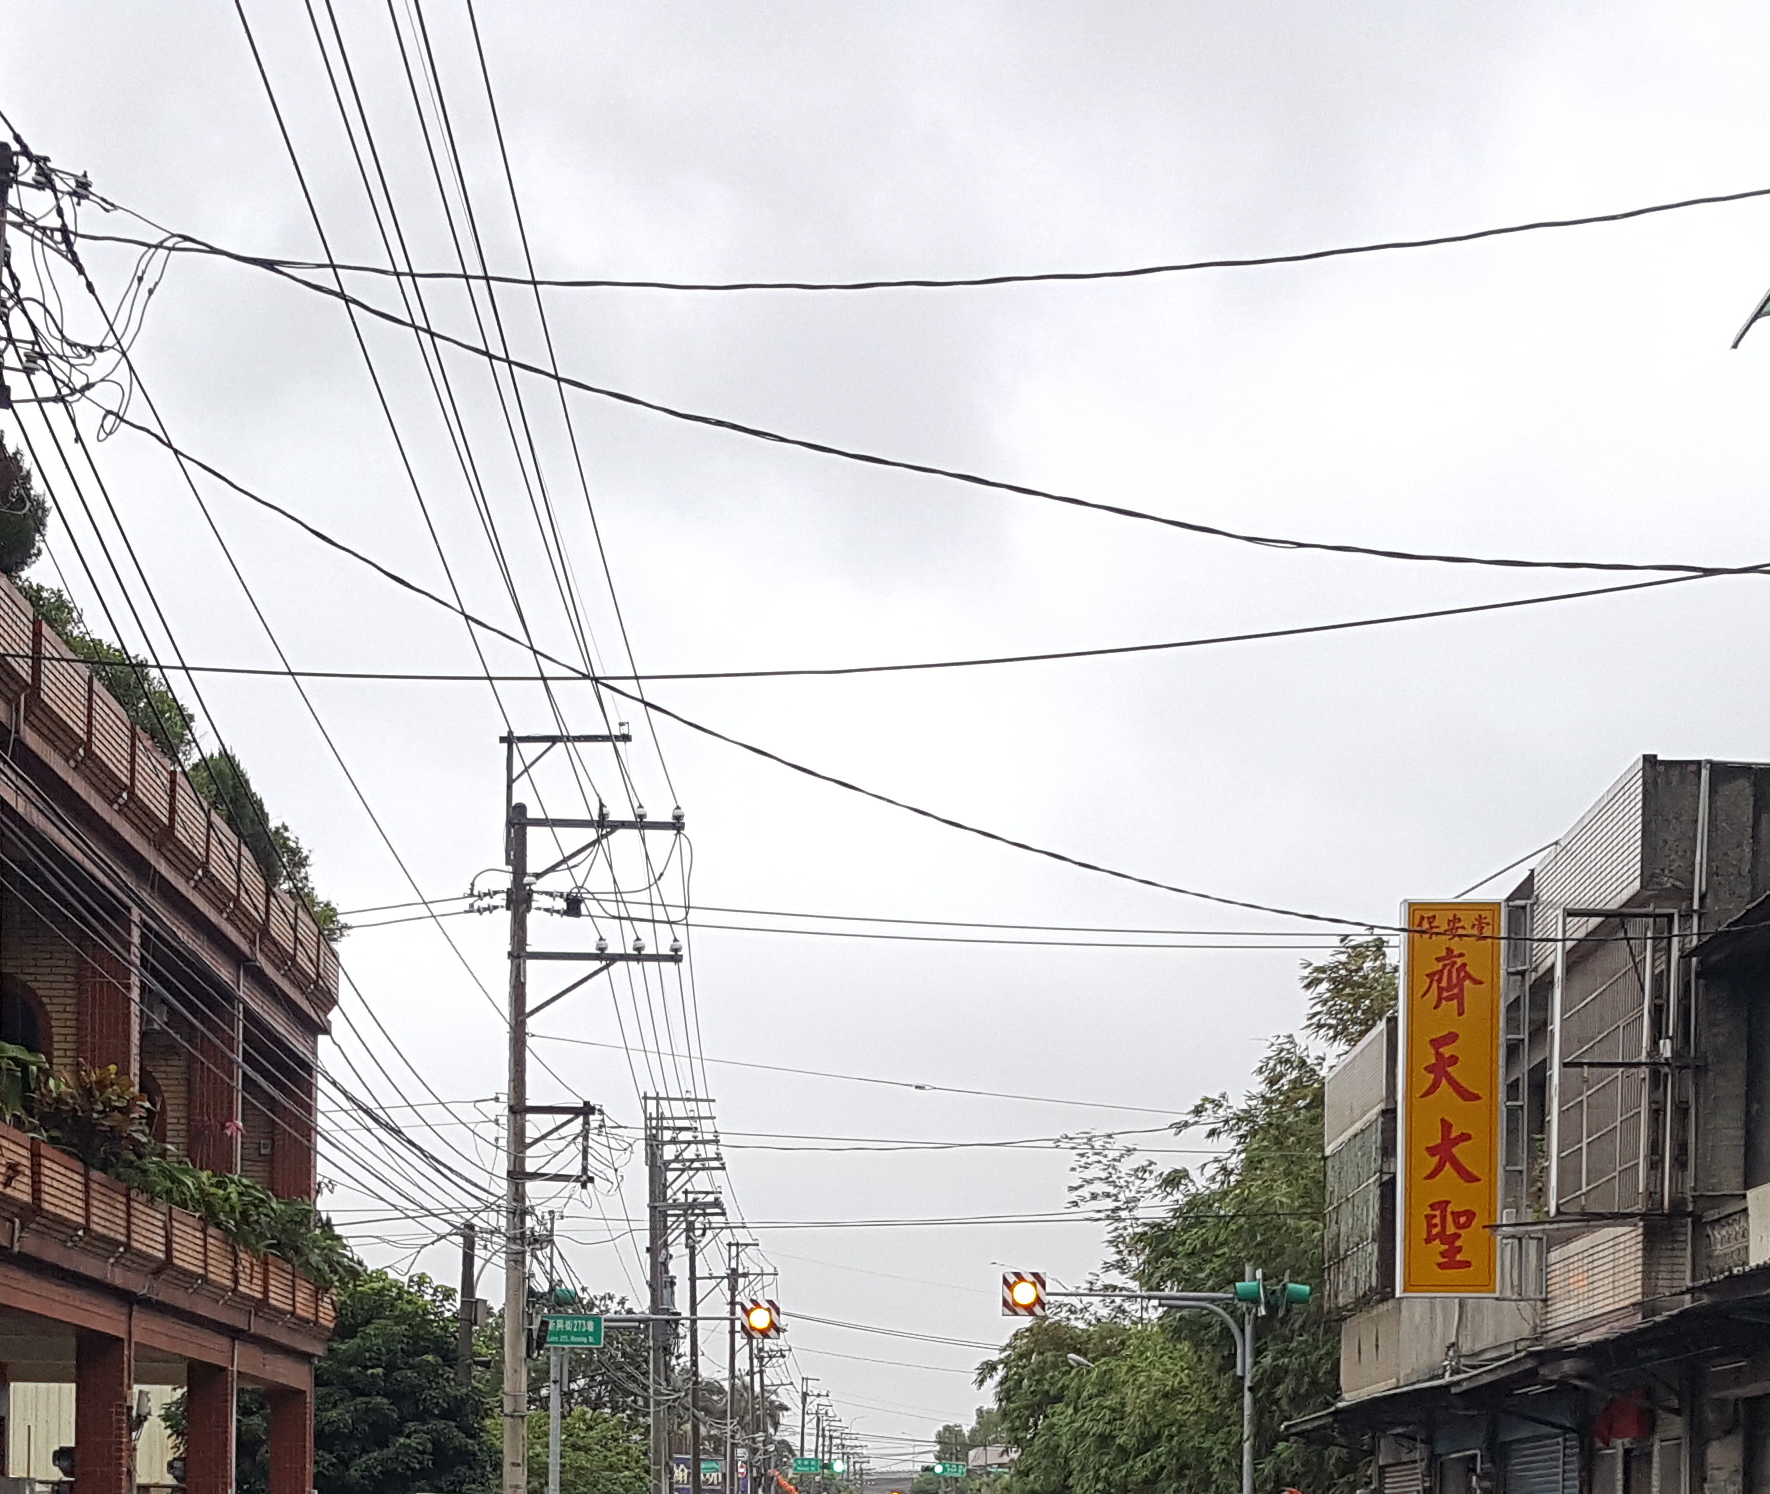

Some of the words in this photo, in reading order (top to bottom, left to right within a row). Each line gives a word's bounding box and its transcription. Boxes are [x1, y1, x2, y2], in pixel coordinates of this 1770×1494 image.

[1417, 913, 1491, 942] 保安堂
[1418, 947, 1484, 1270] 齊天大聖
